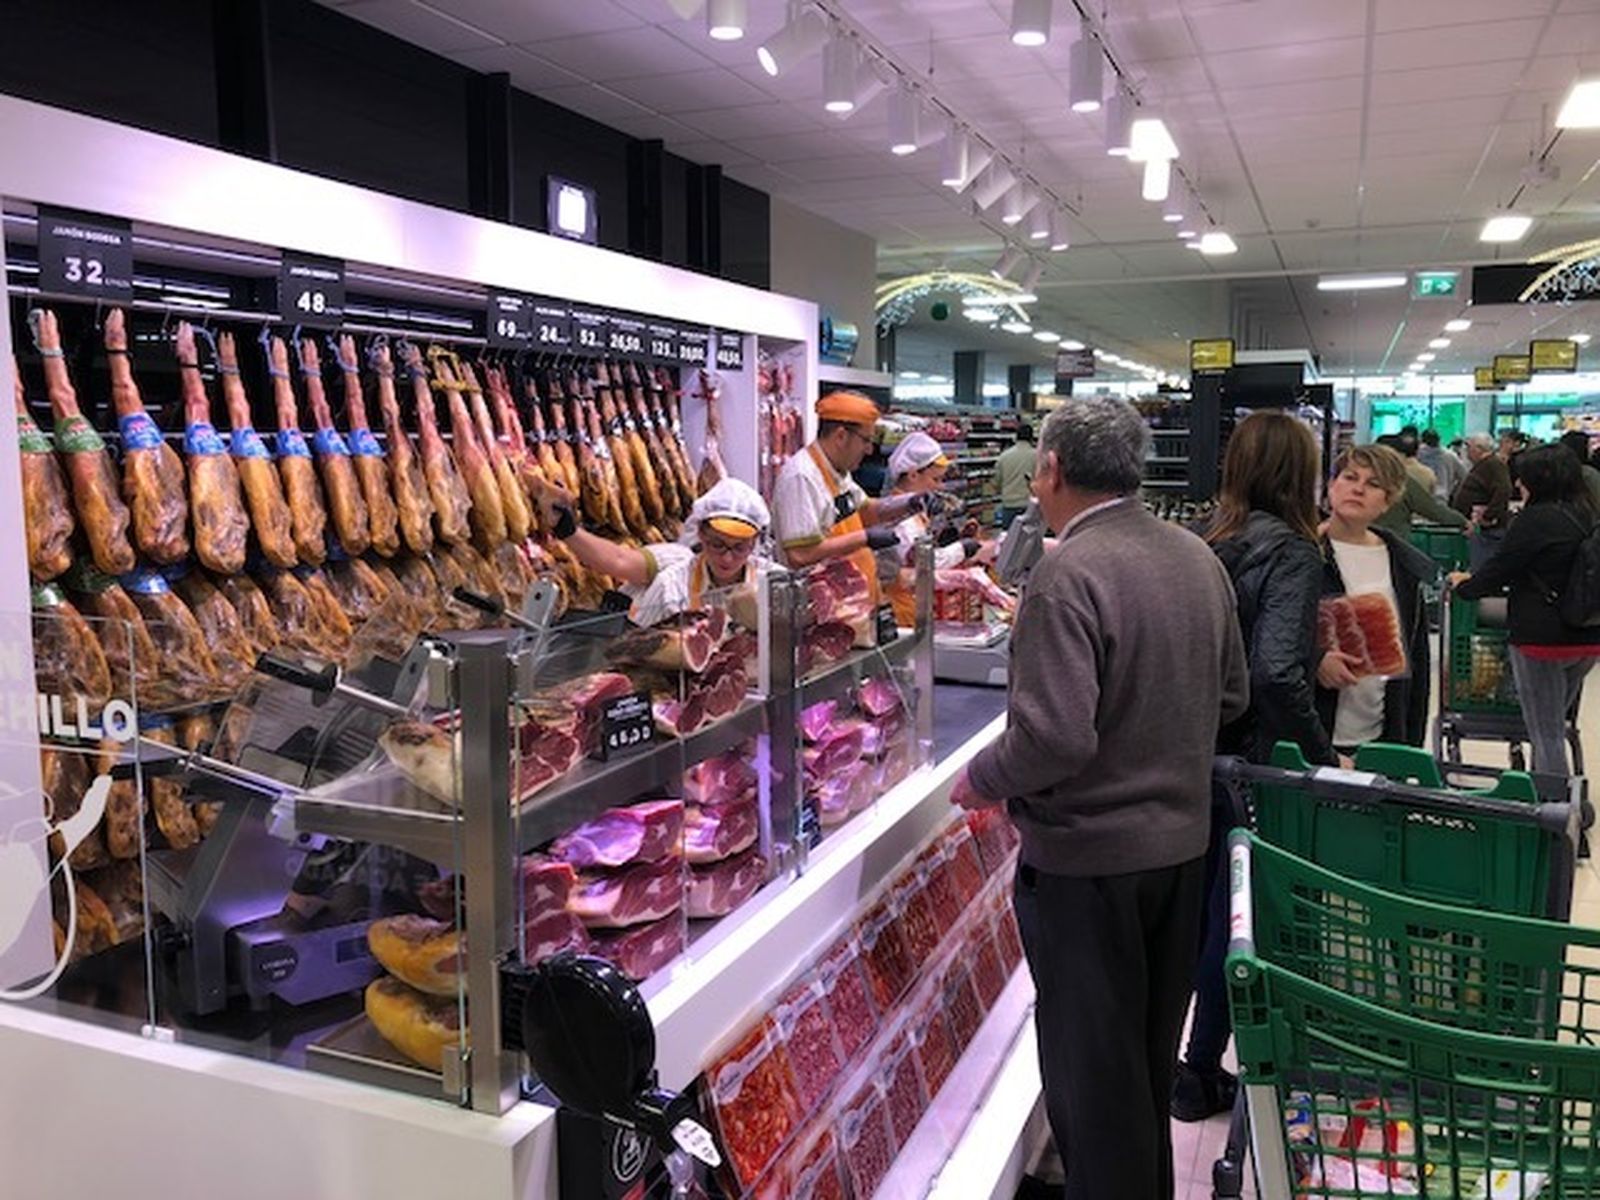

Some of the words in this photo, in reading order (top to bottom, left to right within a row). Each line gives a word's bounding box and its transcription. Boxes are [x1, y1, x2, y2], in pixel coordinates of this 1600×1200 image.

[65, 256, 103, 285] 32
[297, 291, 325, 314] 48
[497, 319, 517, 338] 69
[580, 329, 597, 347] 52
